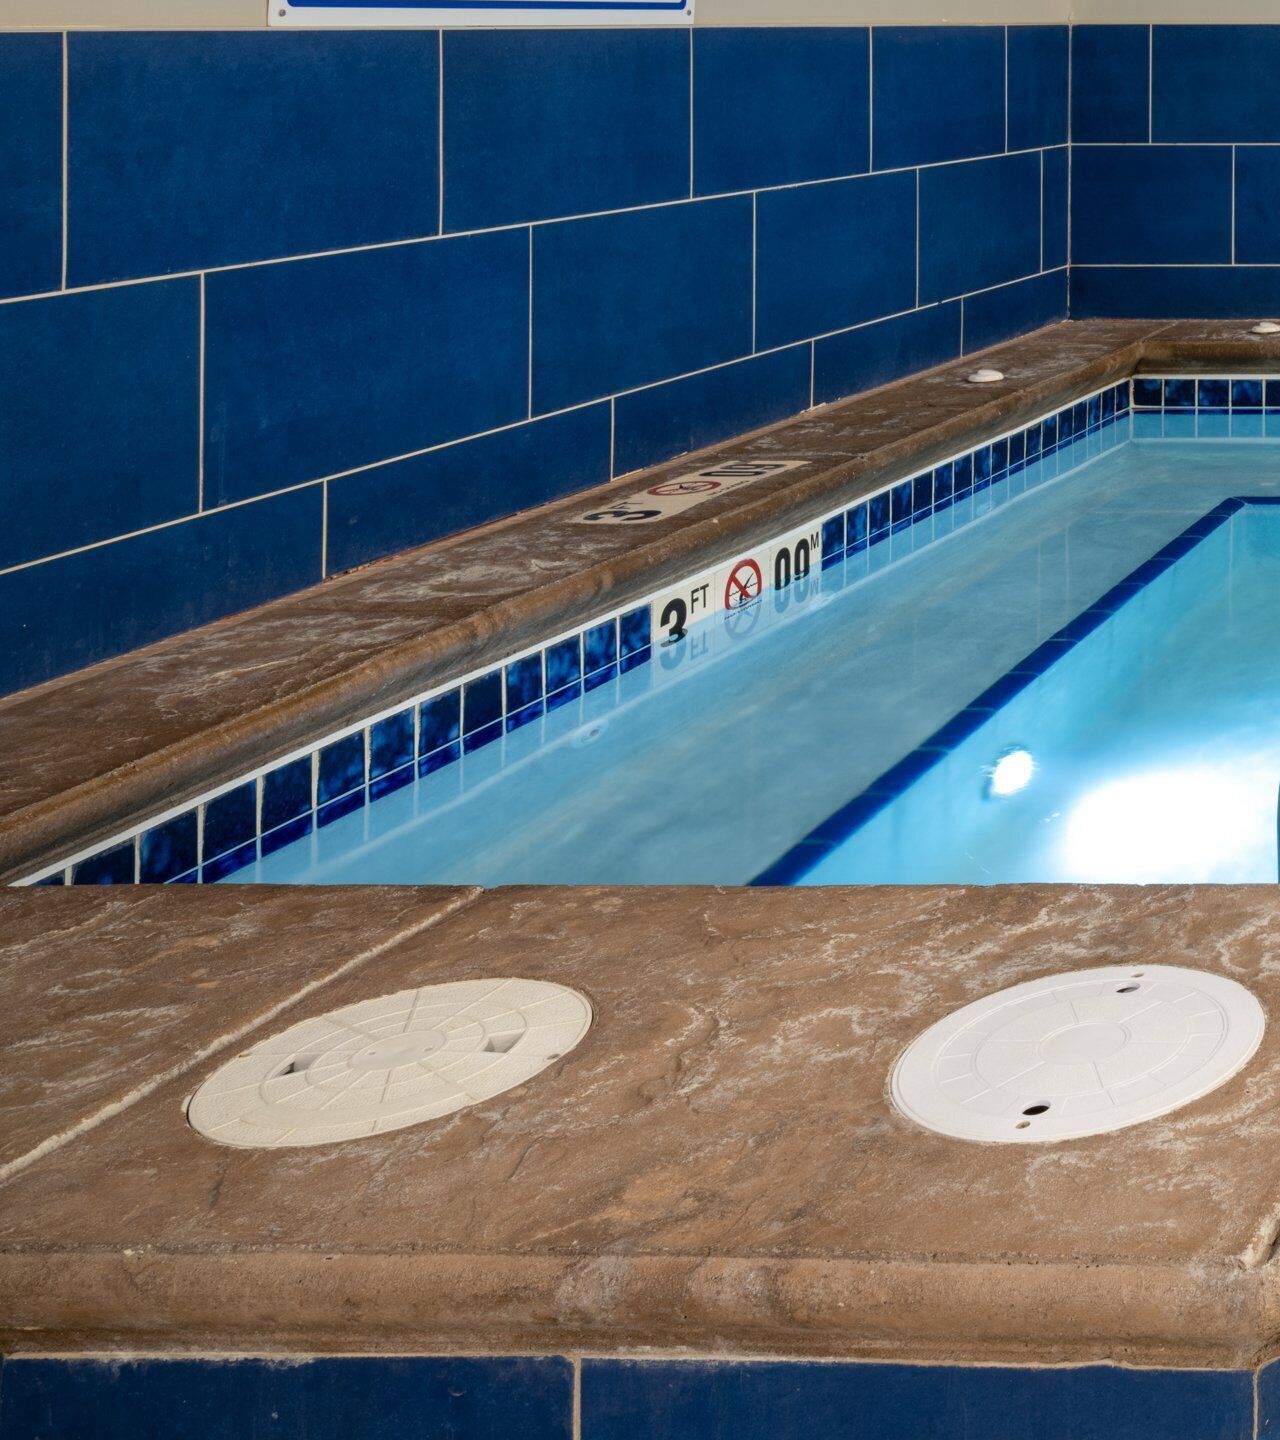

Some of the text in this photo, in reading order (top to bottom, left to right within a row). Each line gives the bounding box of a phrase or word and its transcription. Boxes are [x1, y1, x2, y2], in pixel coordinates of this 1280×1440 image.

[582, 510, 662, 521] 3
[660, 598, 688, 648] 3
[691, 583, 709, 614] FT
[811, 531, 819, 550] M
